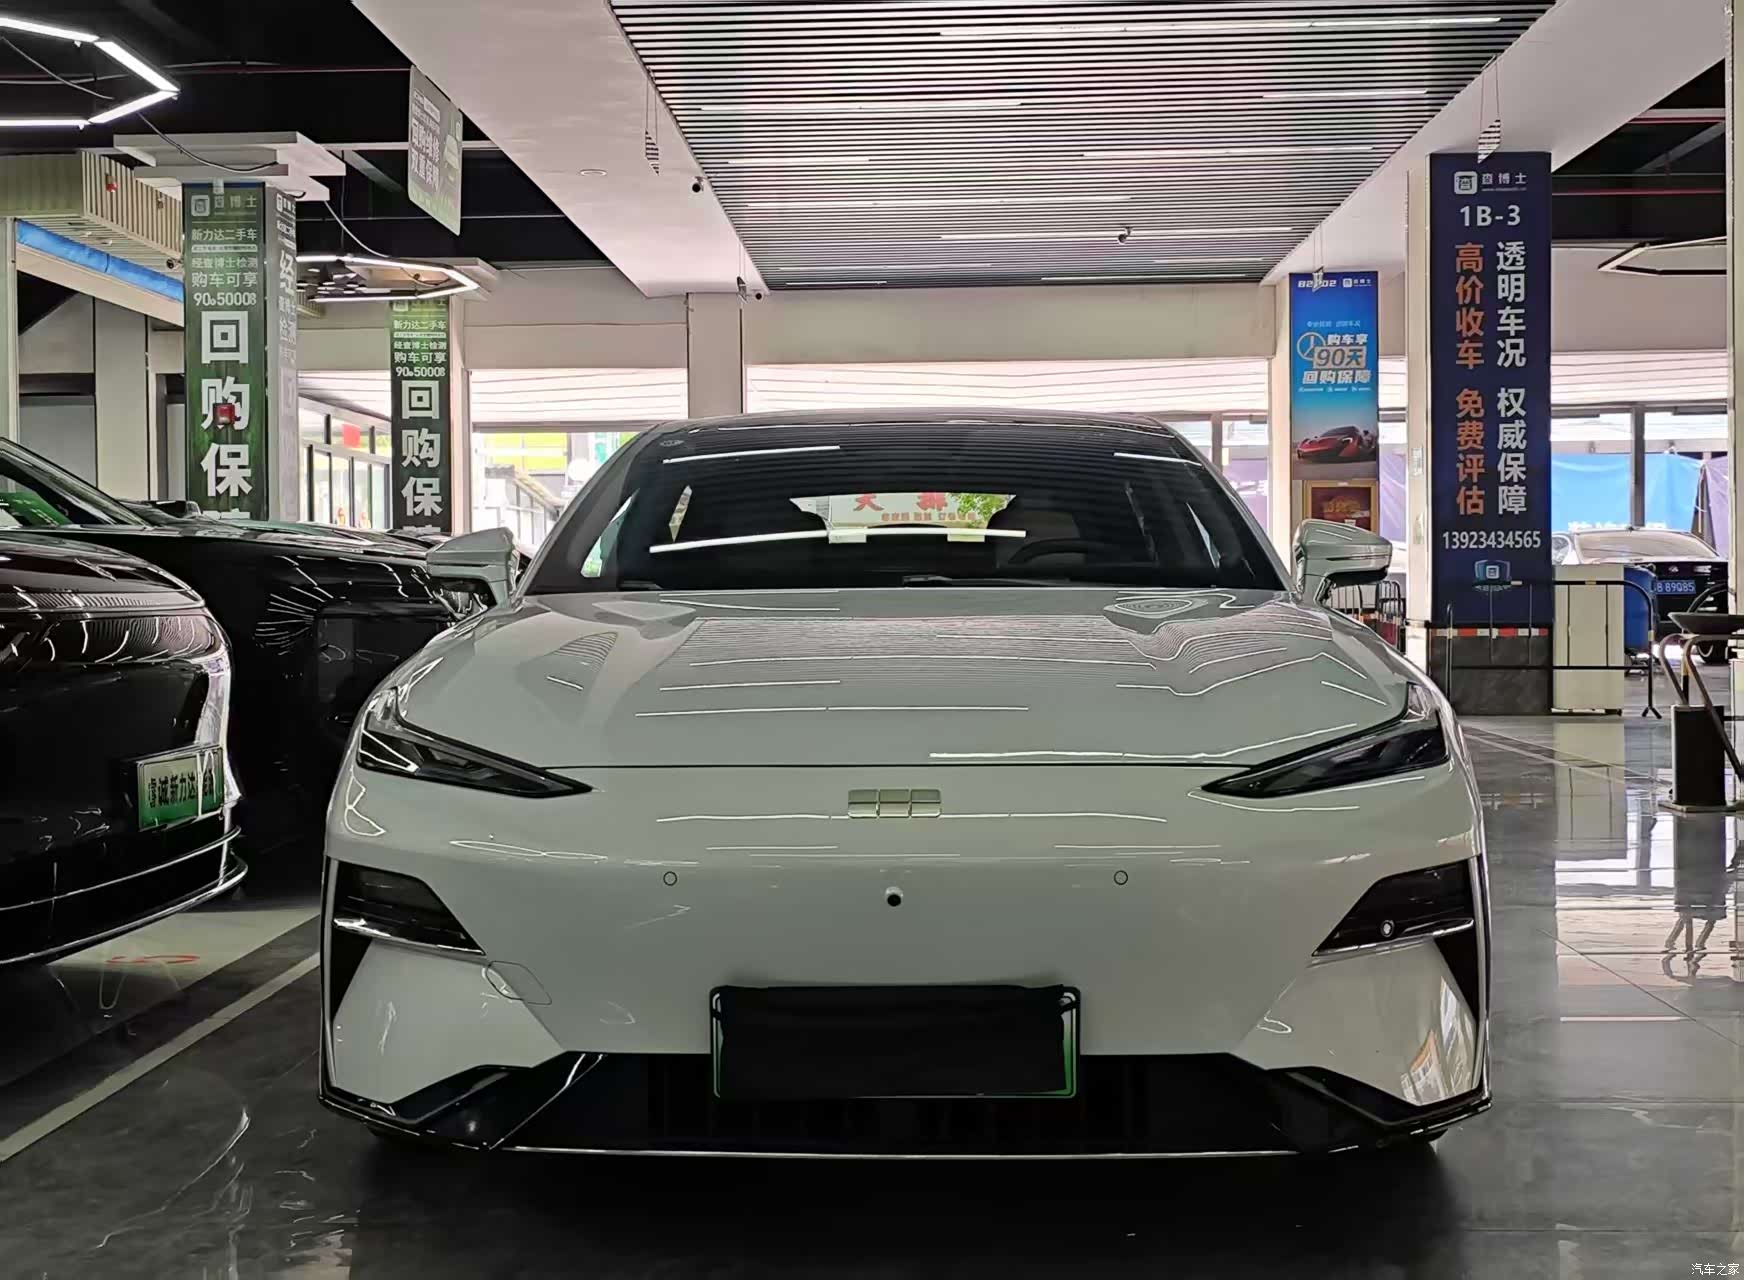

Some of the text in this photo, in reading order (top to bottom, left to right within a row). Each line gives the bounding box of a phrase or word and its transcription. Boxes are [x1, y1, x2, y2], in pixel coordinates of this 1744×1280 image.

[1460, 204, 1521, 227] 1B-3
[191, 228, 257, 241] 新力达二手车
[191, 271, 258, 288] 购车可享
[394, 352, 447, 364] 购车可享
[1316, 348, 1364, 367] 90天
[1455, 242, 1486, 516] 高价收车 免费评估
[1496, 240, 1528, 516] 透明车况 权威保障
[201, 310, 253, 520] 回购保
[401, 380, 443, 534] 回购保
[1442, 530, 1541, 549] 13923434565
